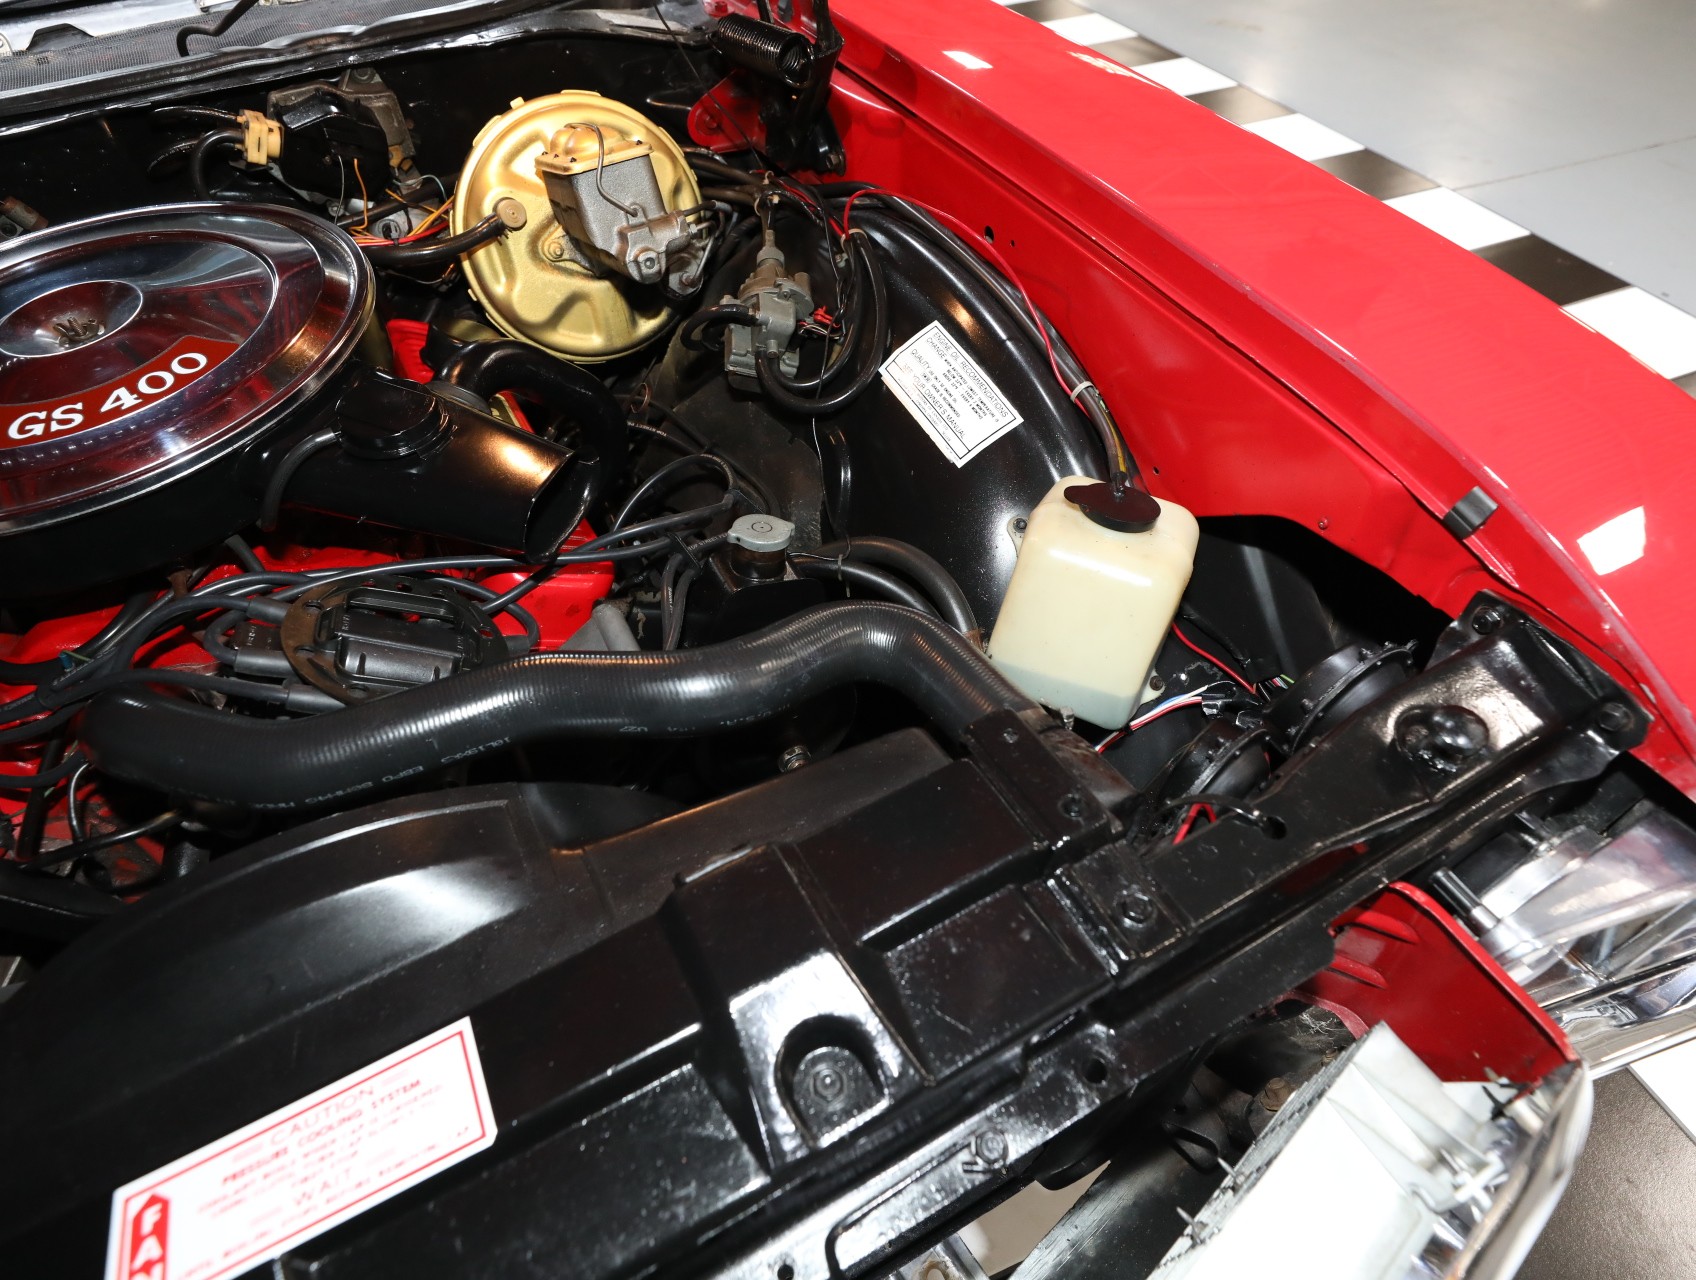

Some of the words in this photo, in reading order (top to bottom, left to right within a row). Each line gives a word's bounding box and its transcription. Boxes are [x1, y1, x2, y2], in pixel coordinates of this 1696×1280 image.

[910, 348, 931, 370] QUALITY
[926, 336, 946, 359] CHANGE
[933, 331, 952, 351] ENGINE
[950, 350, 961, 361] OIL
[958, 360, 1010, 417] RECOMMENDATIONS
[7, 402, 84, 440] GS
[100, 352, 207, 413] 400
[910, 373, 925, 390] YOUR
[923, 388, 947, 415] OWNER'S
[944, 413, 967, 439] MANUAL
[221, 1146, 288, 1187] PRESSURE
[297, 1107, 362, 1148] COOLING
[371, 1077, 421, 1110] SYSTEM
[270, 1084, 375, 1147] CAUTION
[293, 1166, 353, 1207] WAIT
